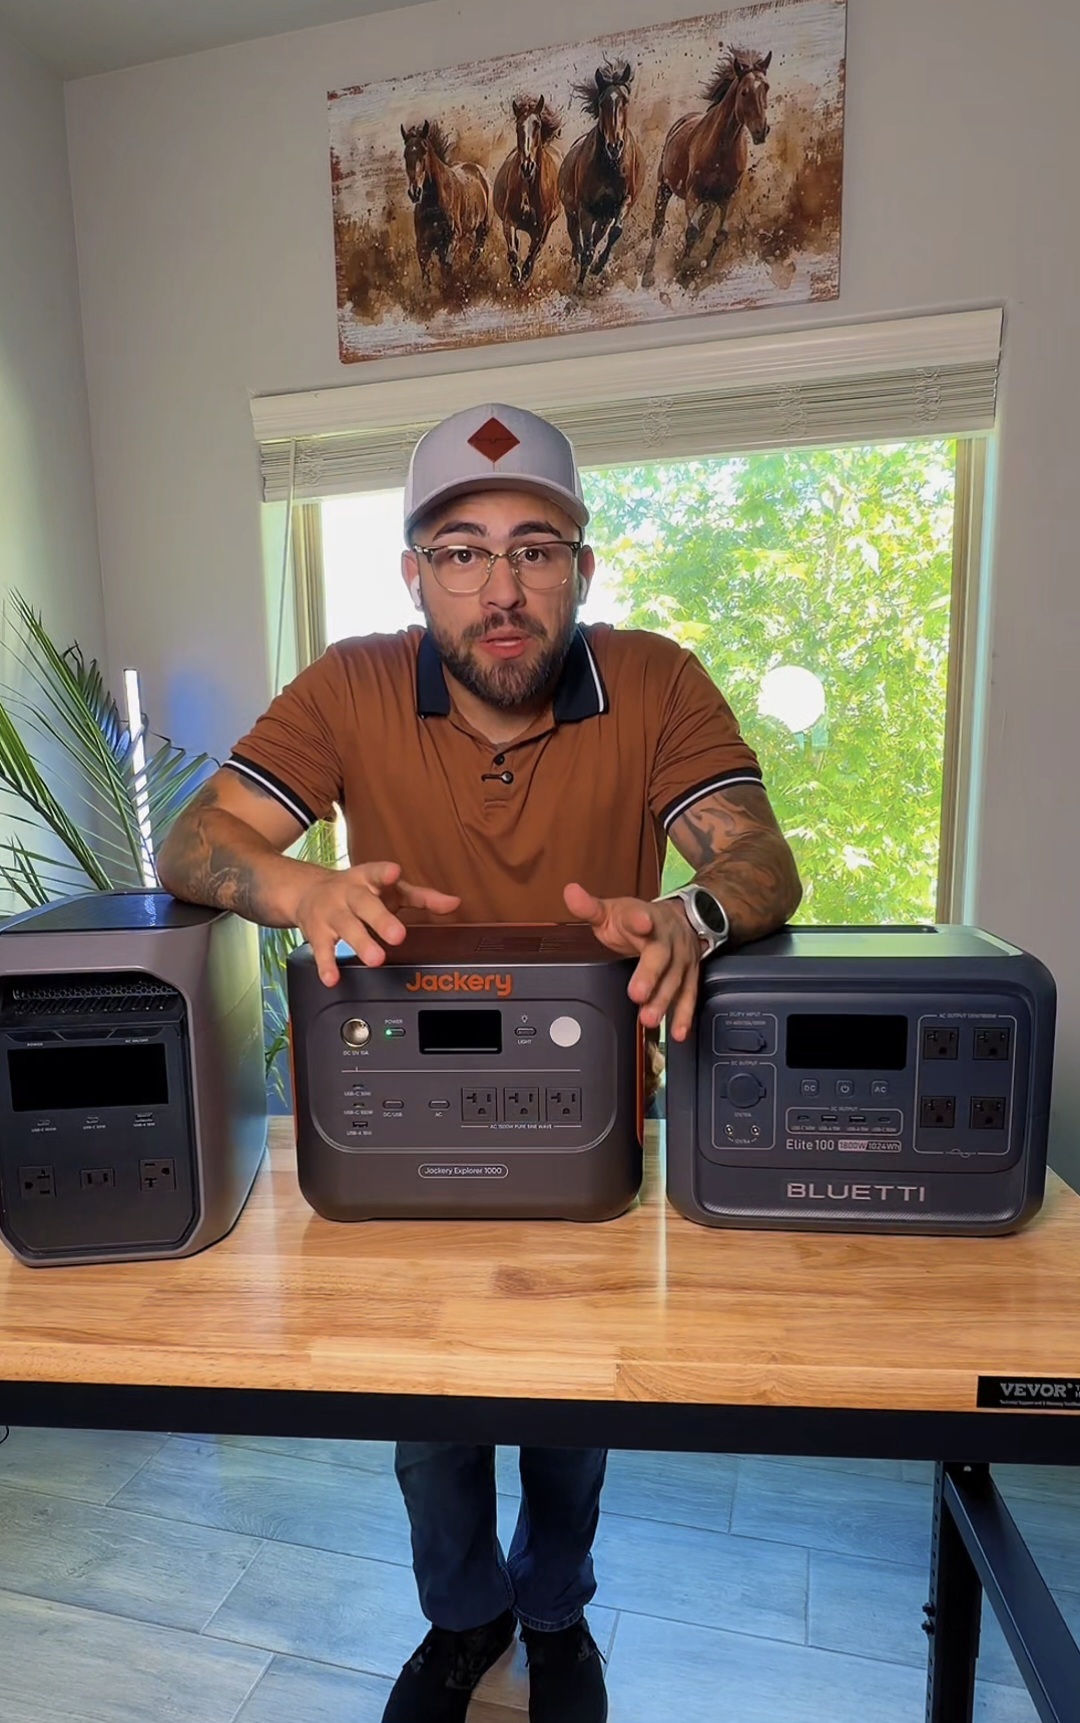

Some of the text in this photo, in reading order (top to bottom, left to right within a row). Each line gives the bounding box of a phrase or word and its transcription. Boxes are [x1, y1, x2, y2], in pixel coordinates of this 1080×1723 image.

[406, 971, 512, 997] Jackery
[786, 1139, 901, 1151] Elite 100 1800W 1024Wh
[424, 1167, 453, 1175] Jackery
[453, 1167, 483, 1175] Explorer
[787, 1182, 925, 1202] BLUETTI
[1000, 1382, 1067, 1398] VEVOR
